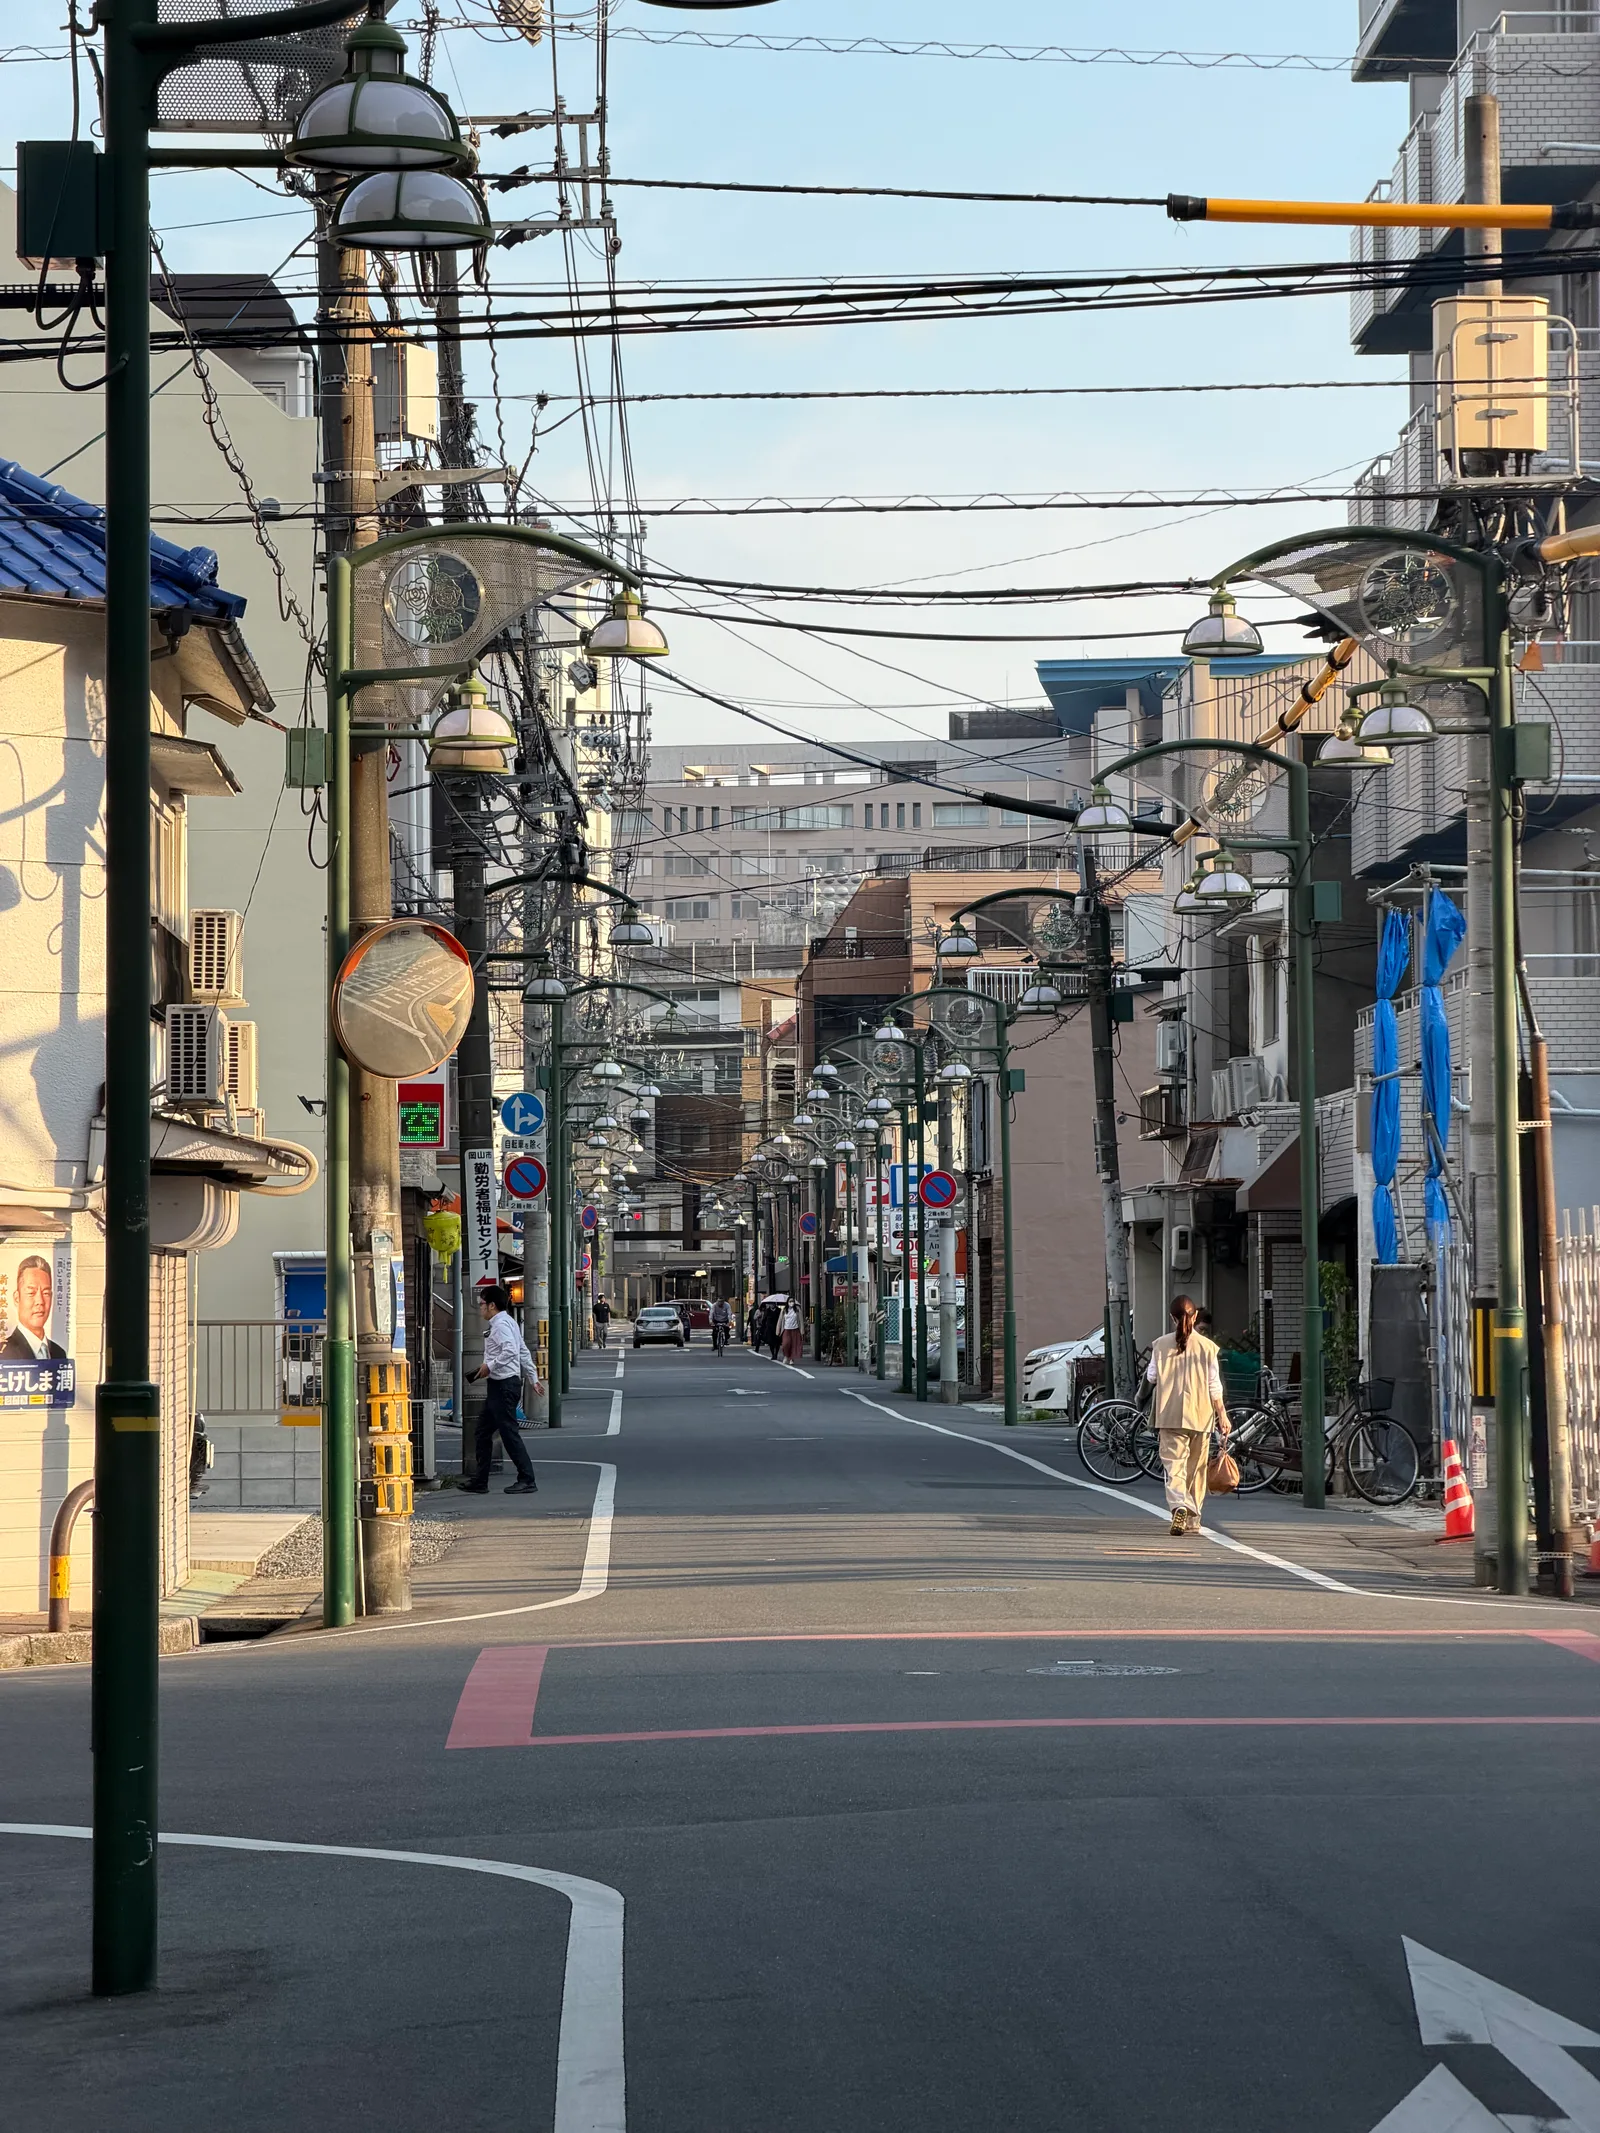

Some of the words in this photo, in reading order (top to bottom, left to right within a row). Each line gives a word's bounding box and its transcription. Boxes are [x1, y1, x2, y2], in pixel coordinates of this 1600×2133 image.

[400, 1102, 440, 1141] 空
[468, 1151, 492, 1160] 岡山市
[504, 1139, 542, 1150] 自転車を除く
[473, 1162, 492, 1271] 勤労者福祉センター
[56, 1369, 74, 1392] 潤
